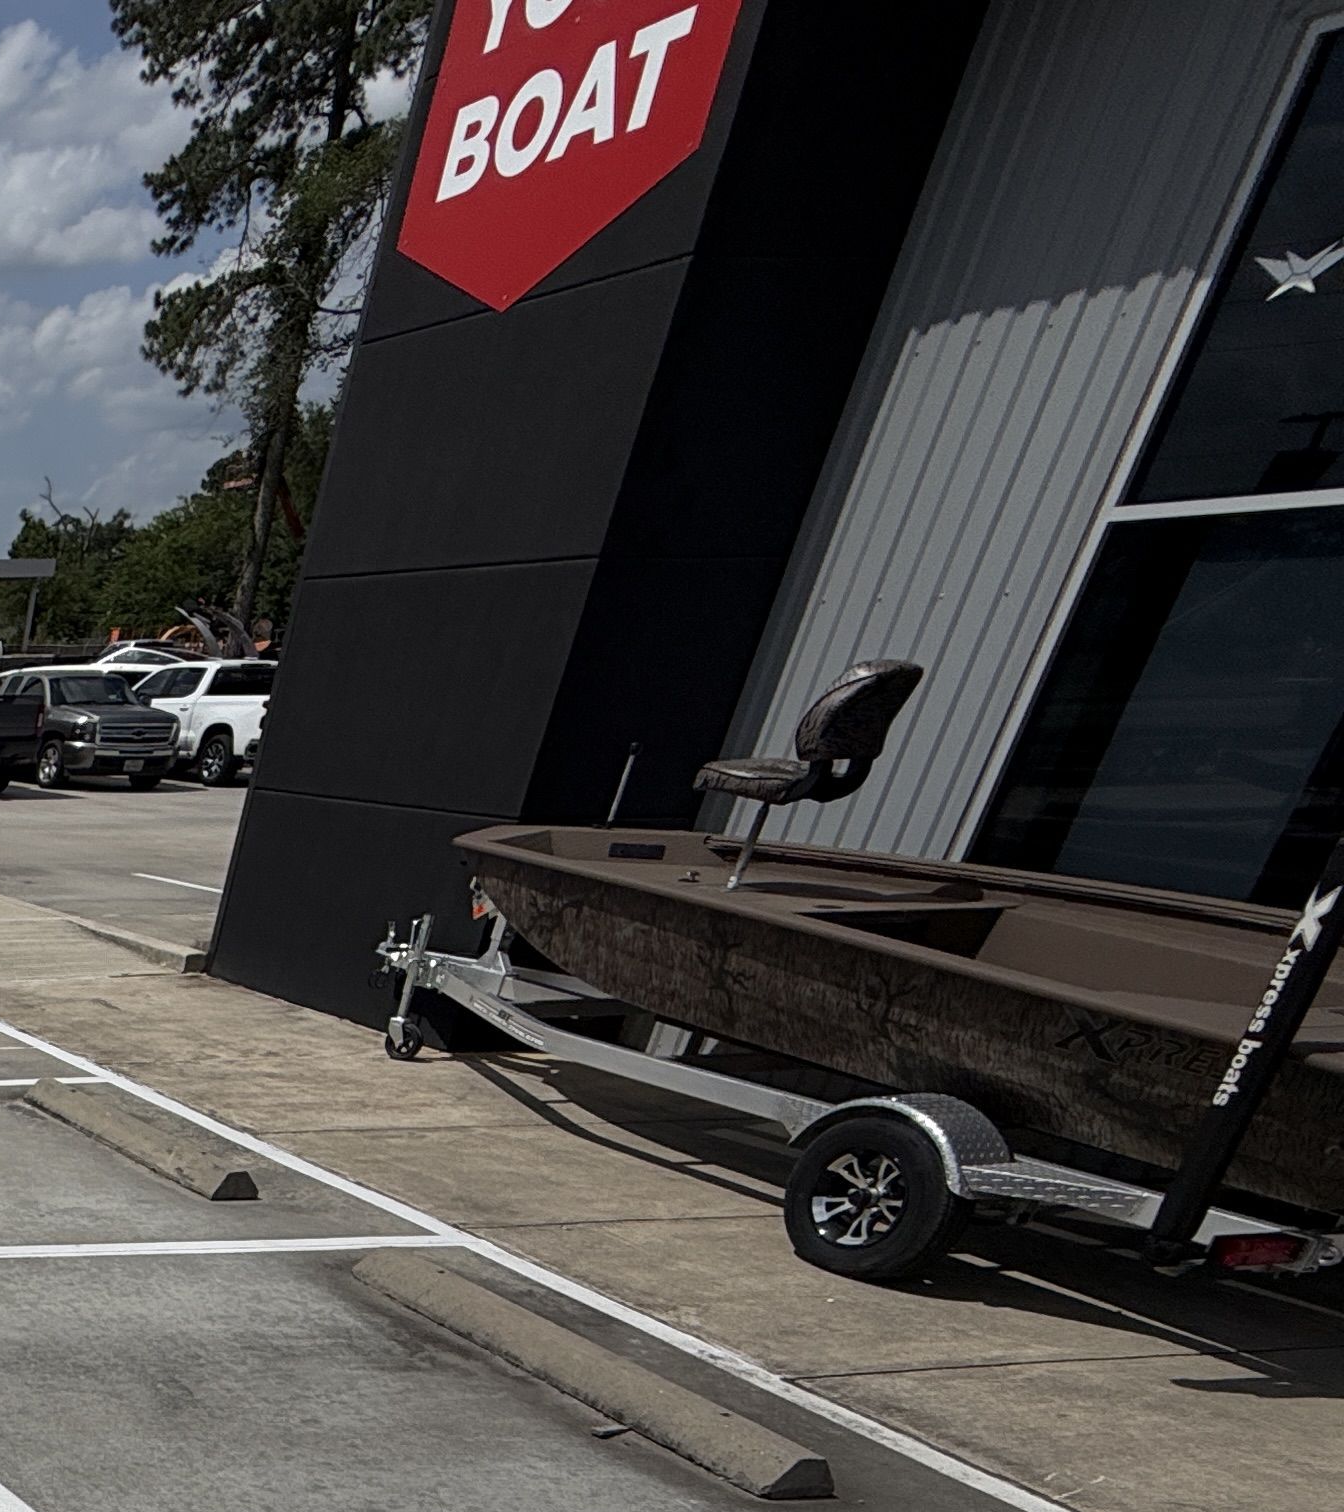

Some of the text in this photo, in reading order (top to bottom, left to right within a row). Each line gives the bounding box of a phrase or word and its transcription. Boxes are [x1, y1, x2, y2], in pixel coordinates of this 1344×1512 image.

[435, 3, 700, 204] BOAT
[1247, 948, 1303, 1034] xpress
[1212, 1037, 1264, 1107] boats
